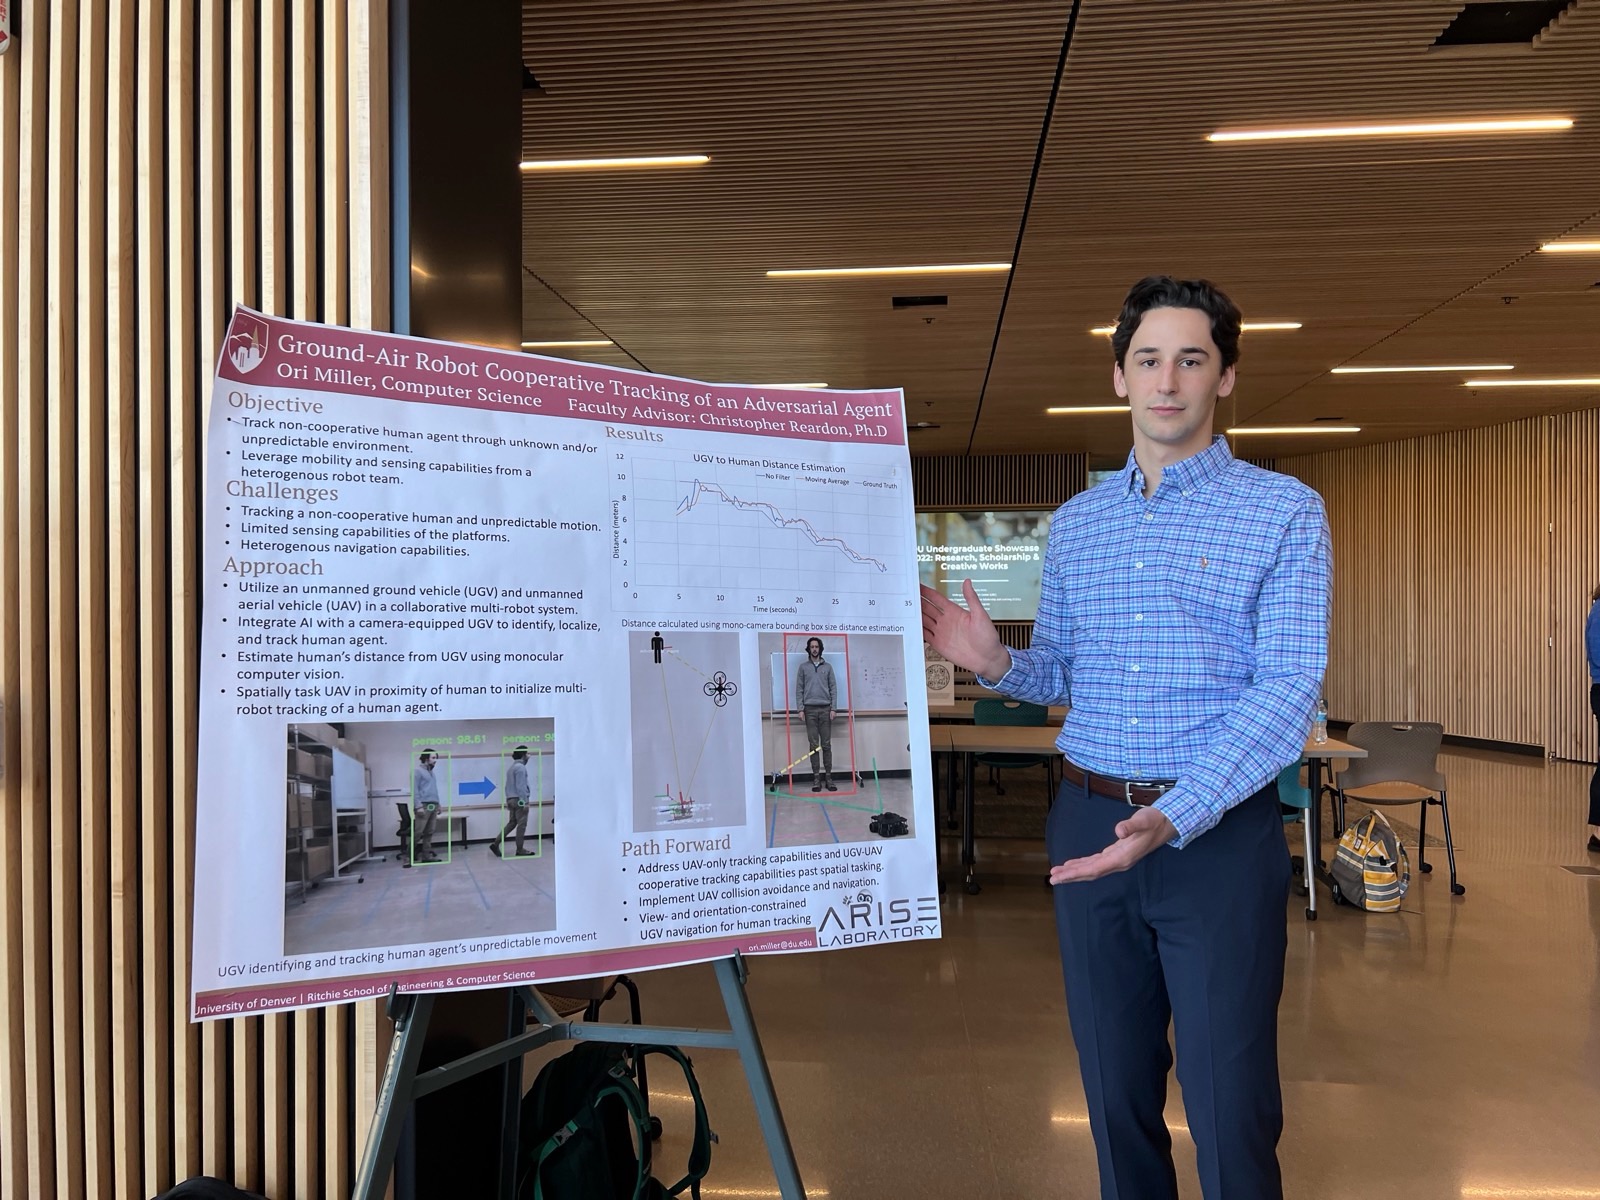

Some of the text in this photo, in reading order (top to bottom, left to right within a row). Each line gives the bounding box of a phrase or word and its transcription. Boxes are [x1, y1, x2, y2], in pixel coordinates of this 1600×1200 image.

[278, 335, 893, 420] Ground-Air Robot Cooperative Tracking of an Adversarial Agent
[228, 391, 323, 414] Objective
[277, 363, 887, 438] Ori Miller, Computer Science Faculty Advisor: Christopher Reardon, Ph.D
[242, 417, 598, 453] Track non-cooperative human agent through unknown and/or
[242, 436, 413, 453] unpredictable environment.
[605, 426, 664, 442] Results
[693, 454, 714, 463] UGV
[728, 457, 760, 467] Human
[763, 460, 799, 470] Distance
[801, 463, 846, 473] Estimation
[227, 480, 338, 505] Challenges
[612, 500, 620, 528] (meters)
[242, 523, 510, 542] Limited sensing capabilities of the platforms.
[241, 539, 470, 557] Heterogenous navigation capabilities.
[926, 545, 993, 554] Undergraduate
[935, 554, 978, 562] Research,
[979, 553, 1031, 562] Scholarship
[222, 556, 323, 578] Approach
[941, 562, 978, 570] Creative
[770, 606, 798, 614] (seconds)
[239, 616, 600, 632] Integrate AI with a camera-equipped UGV to identify, localize,
[622, 619, 656, 628] Distance
[658, 619, 698, 628] calculated
[700, 621, 720, 630] using
[776, 621, 810, 632] bounding
[811, 622, 824, 631] box
[839, 623, 868, 631] distance
[238, 652, 293, 662] Estimate
[354, 651, 405, 662] distance
[408, 651, 437, 662] from
[442, 652, 468, 662] UGV
[471, 652, 501, 664] using
[504, 651, 564, 662] monocular
[237, 669, 344, 682] computer vision.
[237, 683, 587, 700] Spatially task UAV in proximity of human to initialize multi-
[622, 834, 731, 857] Path Forward
[638, 846, 883, 874] Address UAV-only tracking capabilities and UGV-UAV
[639, 877, 879, 908] Implement UAV collision avoidance and navigation.
[639, 898, 806, 923] View- and orientation-constrained
[818, 897, 937, 932] ARISE
[640, 914, 811, 940] UGV navigation for human tracking
[819, 925, 938, 947] LABORATORY
[218, 965, 246, 977] UGV
[249, 960, 312, 974] identifying
[315, 955, 336, 968] and
[339, 952, 384, 965] tracking
[388, 950, 426, 960] human
[470, 936, 541, 953] unpredictable
[544, 932, 597, 945] movement
[748, 939, 812, 952] ori.miller@du.edu
[247, 998, 258, 1009] of
[260, 996, 296, 1007] Denver
[308, 990, 340, 1002] Ritchie
[343, 986, 374, 998] School
[377, 984, 388, 993] of
[390, 980, 444, 992] ngineering
[446, 978, 454, 986] &
[456, 974, 501, 985] Computer
[503, 971, 535, 981] Science
